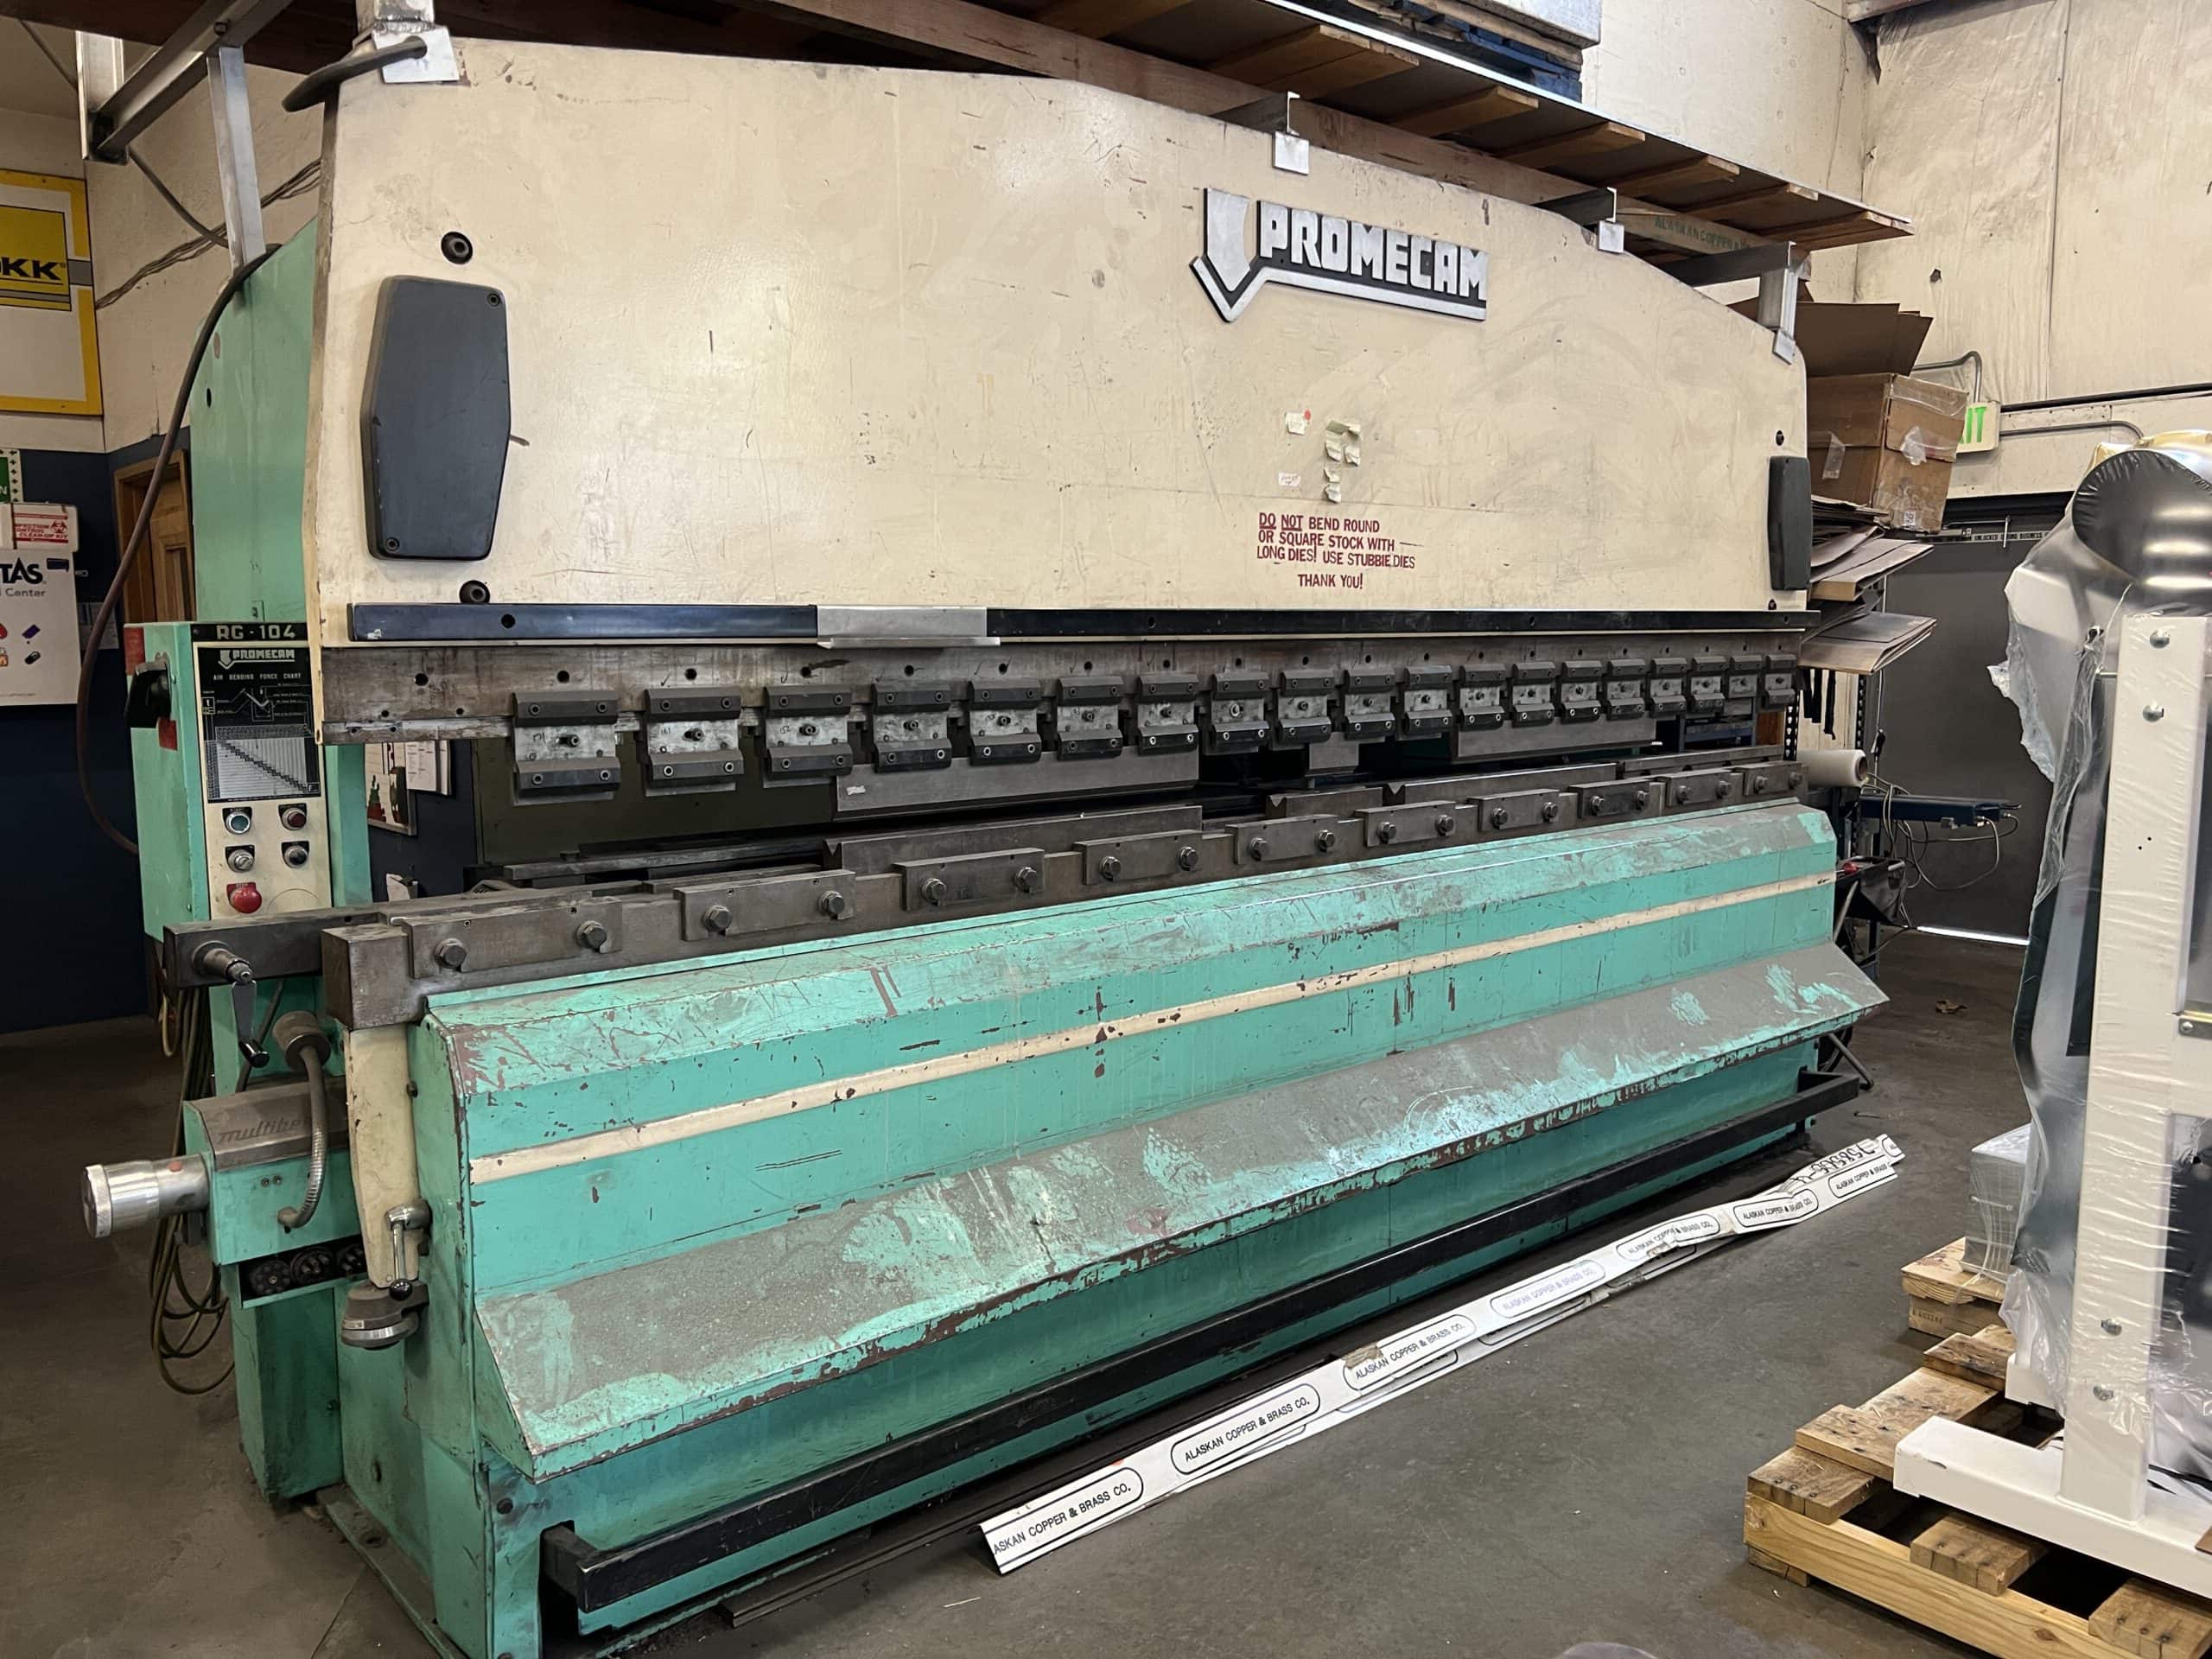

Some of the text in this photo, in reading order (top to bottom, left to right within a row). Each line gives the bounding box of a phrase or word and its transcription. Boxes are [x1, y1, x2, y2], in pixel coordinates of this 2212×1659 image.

[1259, 200, 1488, 302] PROMECAM
[0, 257, 61, 281] KK
[1960, 407, 1986, 443] IT
[1259, 512, 1380, 532] DO NOT BEND ROUND
[1258, 531, 1395, 551] OR SQUARE STOCK WITH
[1257, 546, 1415, 569] LONG DIES! USE STUBBIE DIES
[0, 557, 43, 585] TAS
[1298, 574, 1363, 590] THANK YOU!
[5, 588, 46, 597] Center
[232, 650, 295, 659] PROMECAM
[1743, 1210, 1764, 1220] ALASKAN
[1765, 1207, 1783, 1216] COPPER
[1531, 1284, 1556, 1299] COPPER
[1356, 1357, 1389, 1380] ALASKAN
[1390, 1343, 1420, 1362] COPPER
[1420, 1339, 1427, 1348] &
[1427, 1329, 1451, 1345] BRASS
[1452, 1322, 1465, 1336] CO.
[1185, 1397, 1311, 1463] ALASKAN COPPER & BRASS CO.
[993, 1482, 1131, 1555] ASKAN COPPER & BRASS CO.
